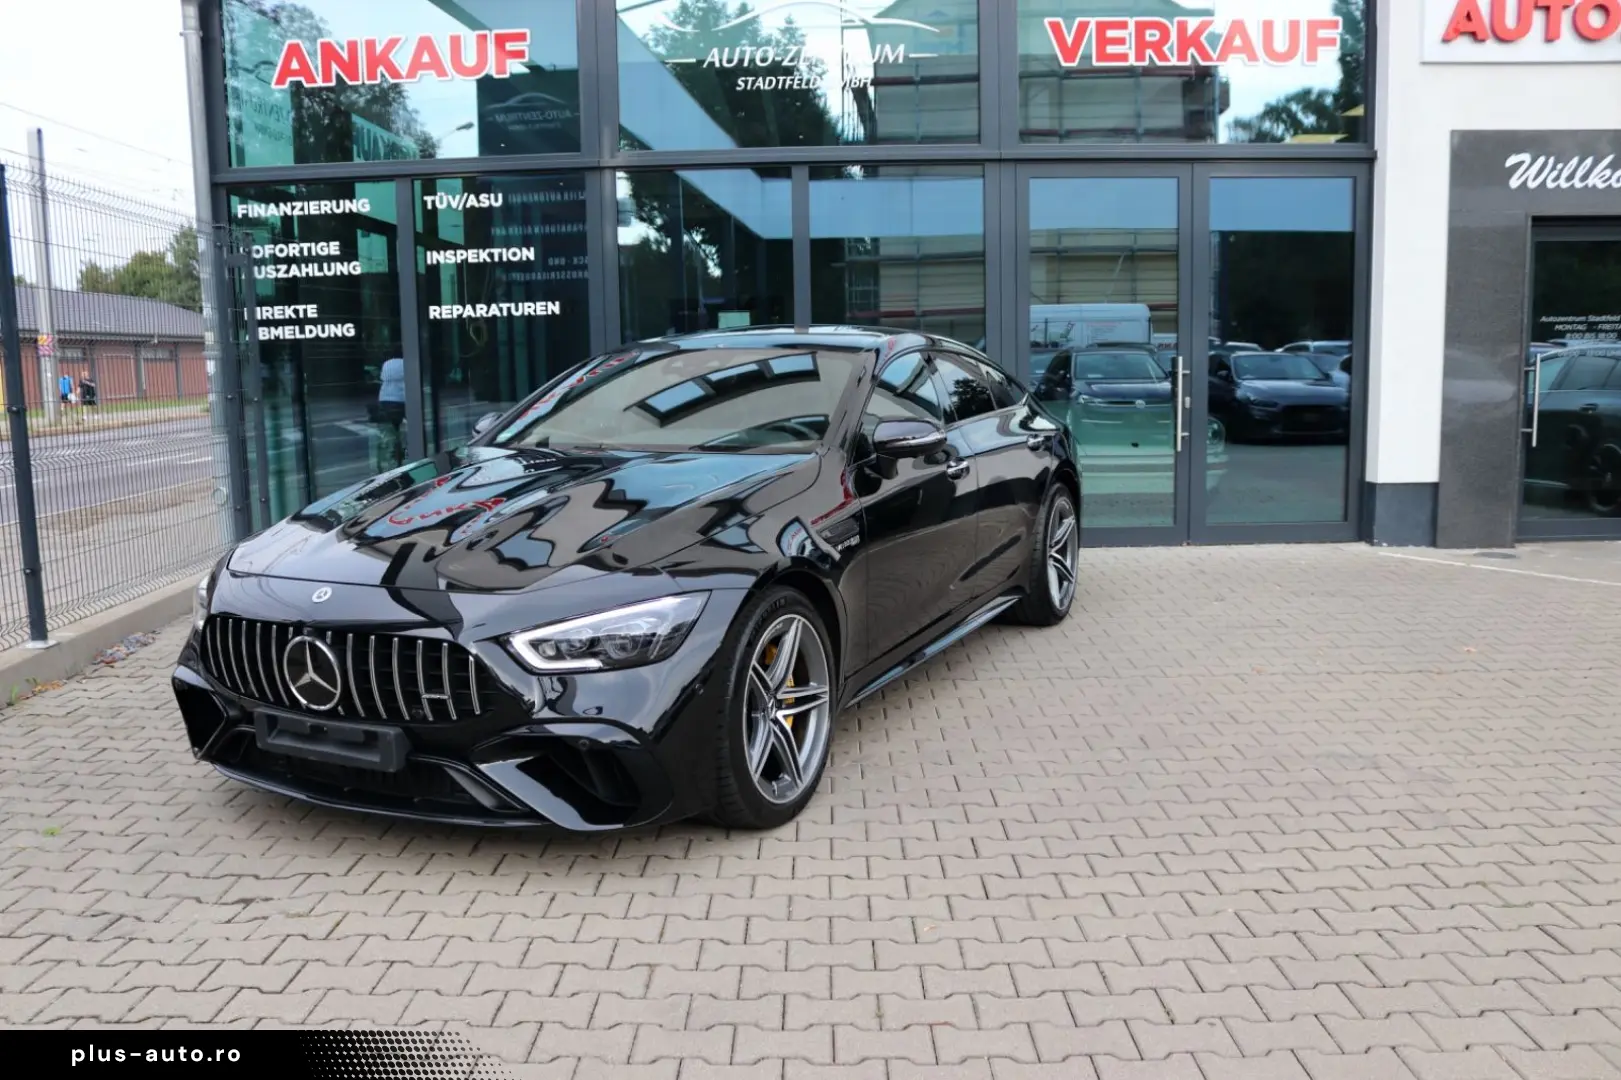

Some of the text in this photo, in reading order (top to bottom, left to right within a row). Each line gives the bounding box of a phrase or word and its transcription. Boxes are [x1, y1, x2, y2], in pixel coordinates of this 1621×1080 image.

[1441, 0, 1621, 43] AUTO
[1044, 16, 1342, 67] VERKAUF
[271, 28, 531, 89] ANKAUF
[736, 75, 820, 91] STADTFELD
[237, 198, 371, 219] FINANZIERUNG
[423, 191, 504, 211] TÜV/ASU
[239, 241, 341, 259] OFORTIGE
[426, 246, 536, 265] INSPEKTION
[241, 260, 362, 280] USZAHLUNG
[244, 303, 319, 321] IREKTE
[428, 300, 561, 320] REPARATUREN
[1540, 315, 1587, 323] Autozentrum
[246, 322, 356, 341] BMELDUNG
[1554, 323, 1588, 331] MONTAG
